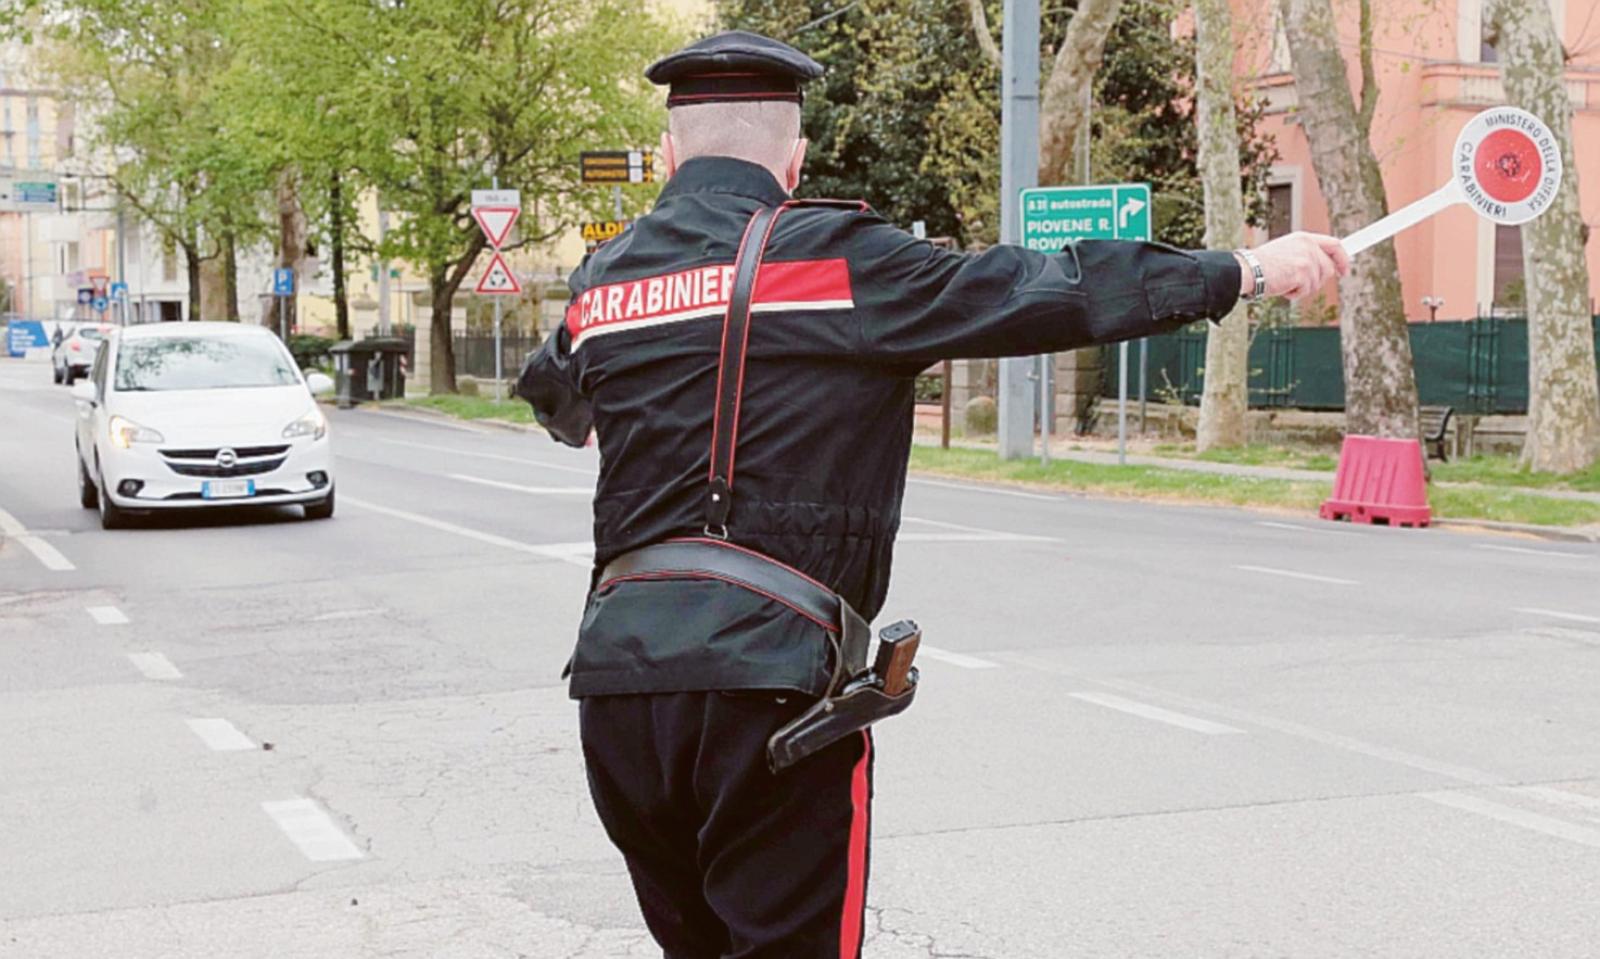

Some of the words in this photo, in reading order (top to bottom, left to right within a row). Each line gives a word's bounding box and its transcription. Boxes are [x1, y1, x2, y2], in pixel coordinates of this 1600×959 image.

[1485, 113, 1541, 138] MINISTERO
[1538, 138, 1556, 173] DELLA
[1459, 141, 1507, 217] CARABINIERI
[1051, 198, 1112, 210] autostrada
[1527, 177, 1555, 211] DIFESA
[583, 222, 624, 239] ALDI
[1027, 218, 1093, 233] PIOVENE
[1098, 217, 1112, 231] R.
[1027, 237, 1085, 251] ROVI
[580, 265, 735, 328] CARABINIER
